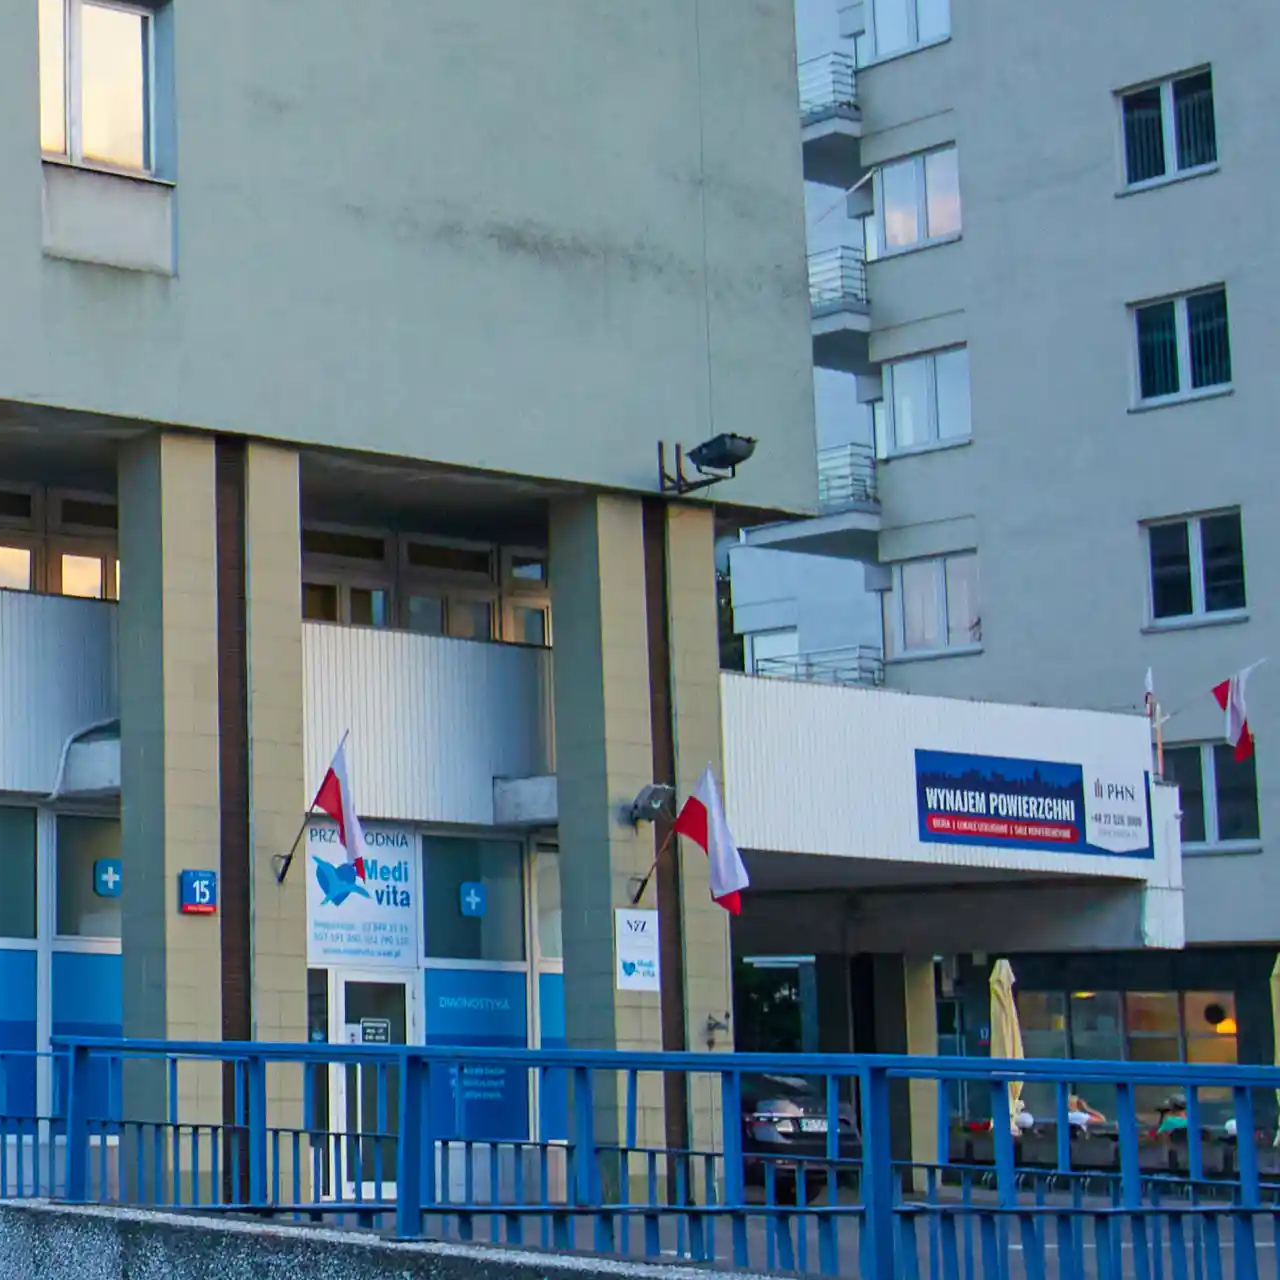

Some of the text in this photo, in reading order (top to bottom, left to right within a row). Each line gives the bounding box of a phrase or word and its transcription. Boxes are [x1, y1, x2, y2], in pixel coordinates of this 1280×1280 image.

[925, 786, 1075, 821] WYNAJEM POWIERZCHNI
[1107, 782, 1135, 801] PHN
[309, 827, 409, 848] PRZODNIA
[363, 858, 409, 883] Medi
[192, 879, 210, 904] 15
[375, 884, 410, 908] vita
